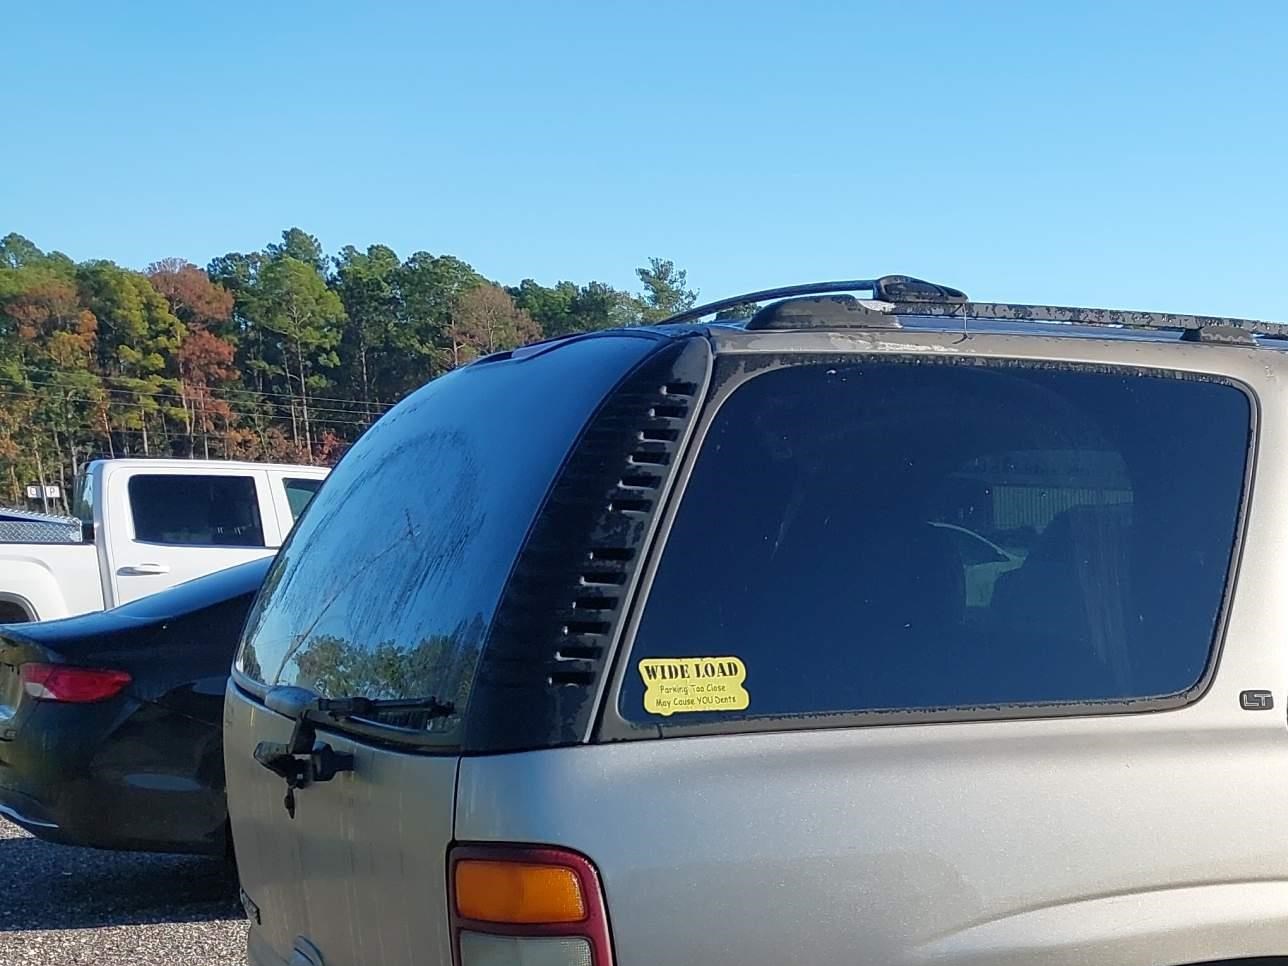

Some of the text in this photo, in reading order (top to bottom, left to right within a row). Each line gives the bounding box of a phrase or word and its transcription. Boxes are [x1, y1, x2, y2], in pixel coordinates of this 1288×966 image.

[644, 661, 738, 681] WIDE LOAD
[660, 683, 726, 695] Parking Too Close
[656, 695, 737, 708] May Cause YOU Dents
[1243, 693, 1272, 706] LT
